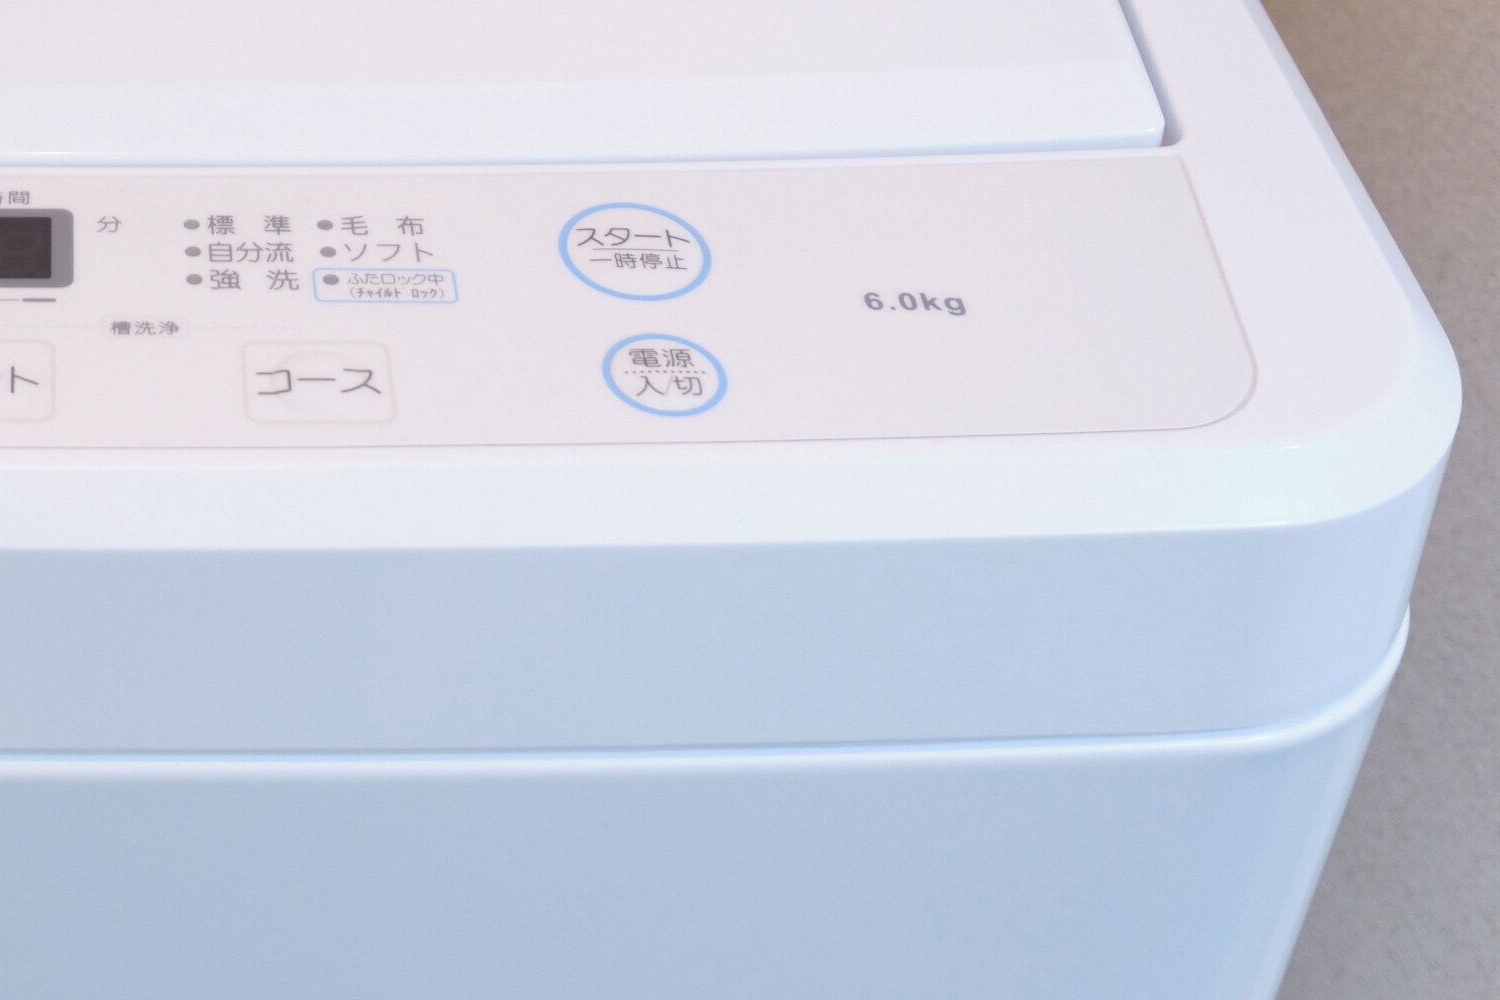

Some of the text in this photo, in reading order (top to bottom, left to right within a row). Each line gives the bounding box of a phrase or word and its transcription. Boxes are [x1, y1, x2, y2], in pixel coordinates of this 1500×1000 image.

[96, 215, 123, 234] 分
[206, 214, 292, 236] 標準
[340, 215, 424, 237] 毛布
[576, 227, 690, 248] スタート
[208, 241, 295, 263] 自分流
[342, 241, 435, 263] ソフト
[589, 252, 688, 271] 一時停止
[209, 268, 300, 291] 強洗
[347, 272, 444, 286] ふたロック中
[863, 291, 967, 317] 6.0kg
[110, 320, 180, 336] 槽洗浄
[628, 347, 695, 369] 電源
[256, 367, 382, 396] コース
